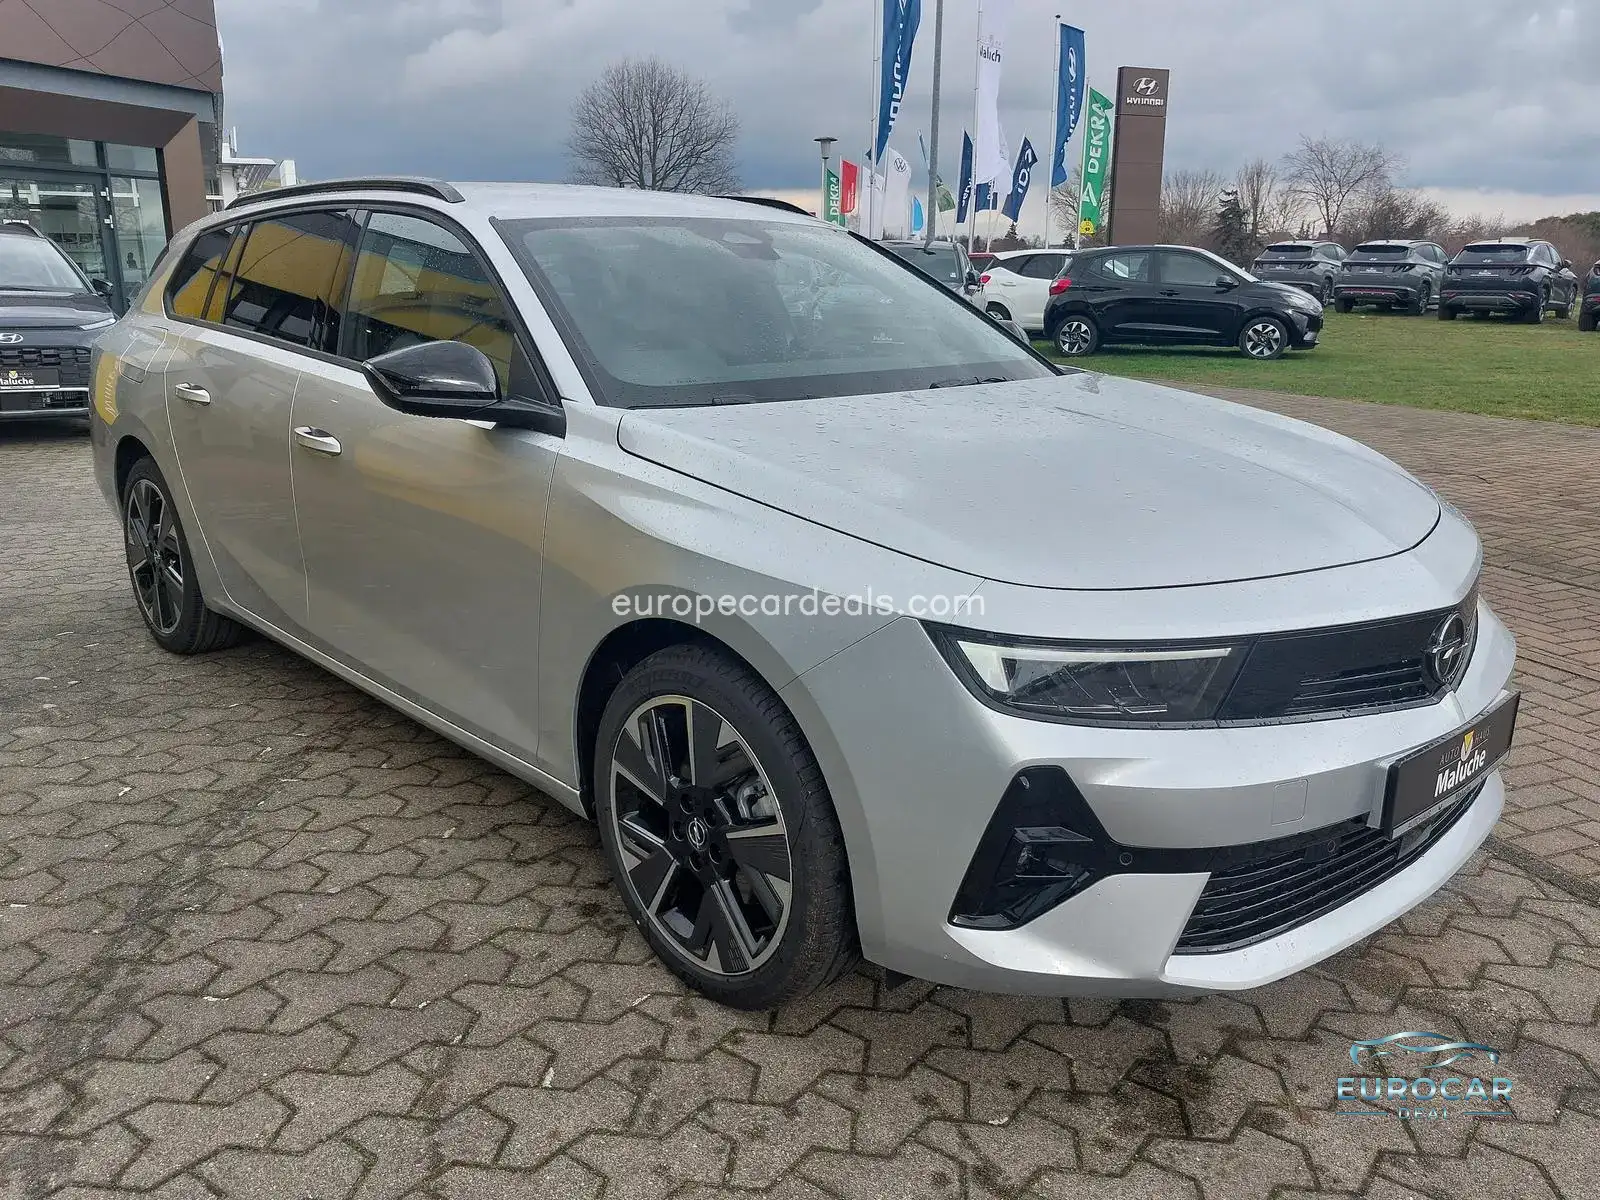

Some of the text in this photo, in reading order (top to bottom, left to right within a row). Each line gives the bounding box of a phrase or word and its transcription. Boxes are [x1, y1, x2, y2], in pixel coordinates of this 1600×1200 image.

[1126, 97, 1164, 106] HYUNDAI
[1087, 103, 1106, 174] DEKRA
[829, 177, 840, 216] DEKRA
[1434, 749, 1486, 797] Maluche
[1440, 746, 1460, 765] AUTO
